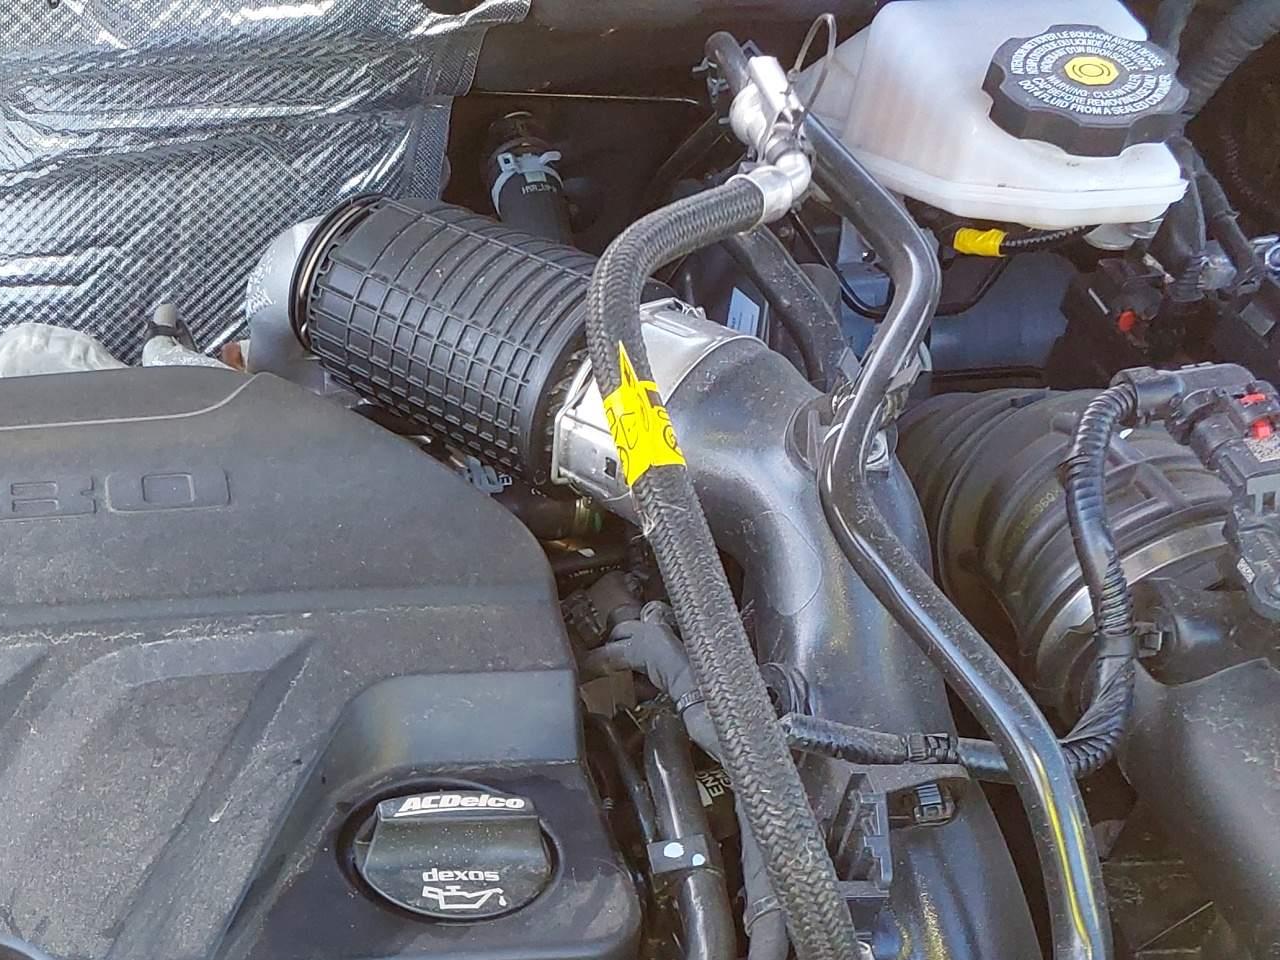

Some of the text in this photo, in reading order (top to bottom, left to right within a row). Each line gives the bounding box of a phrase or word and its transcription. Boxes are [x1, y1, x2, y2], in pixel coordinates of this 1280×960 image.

[1055, 31, 1072, 39] LE
[1069, 31, 1113, 42] BOUCHON
[1111, 36, 1143, 51] AVANT
[1069, 39, 1104, 47] LIQUIDE
[1086, 47, 1113, 57] BIDON
[1031, 78, 1053, 90] CAP
[1045, 87, 1086, 104] BEFORE
[1036, 93, 1070, 109] FLUID
[1068, 104, 1102, 114] FROM
[1103, 106, 1112, 115] A
[398, 794, 525, 813] ACDelco
[422, 868, 500, 882] dexos
